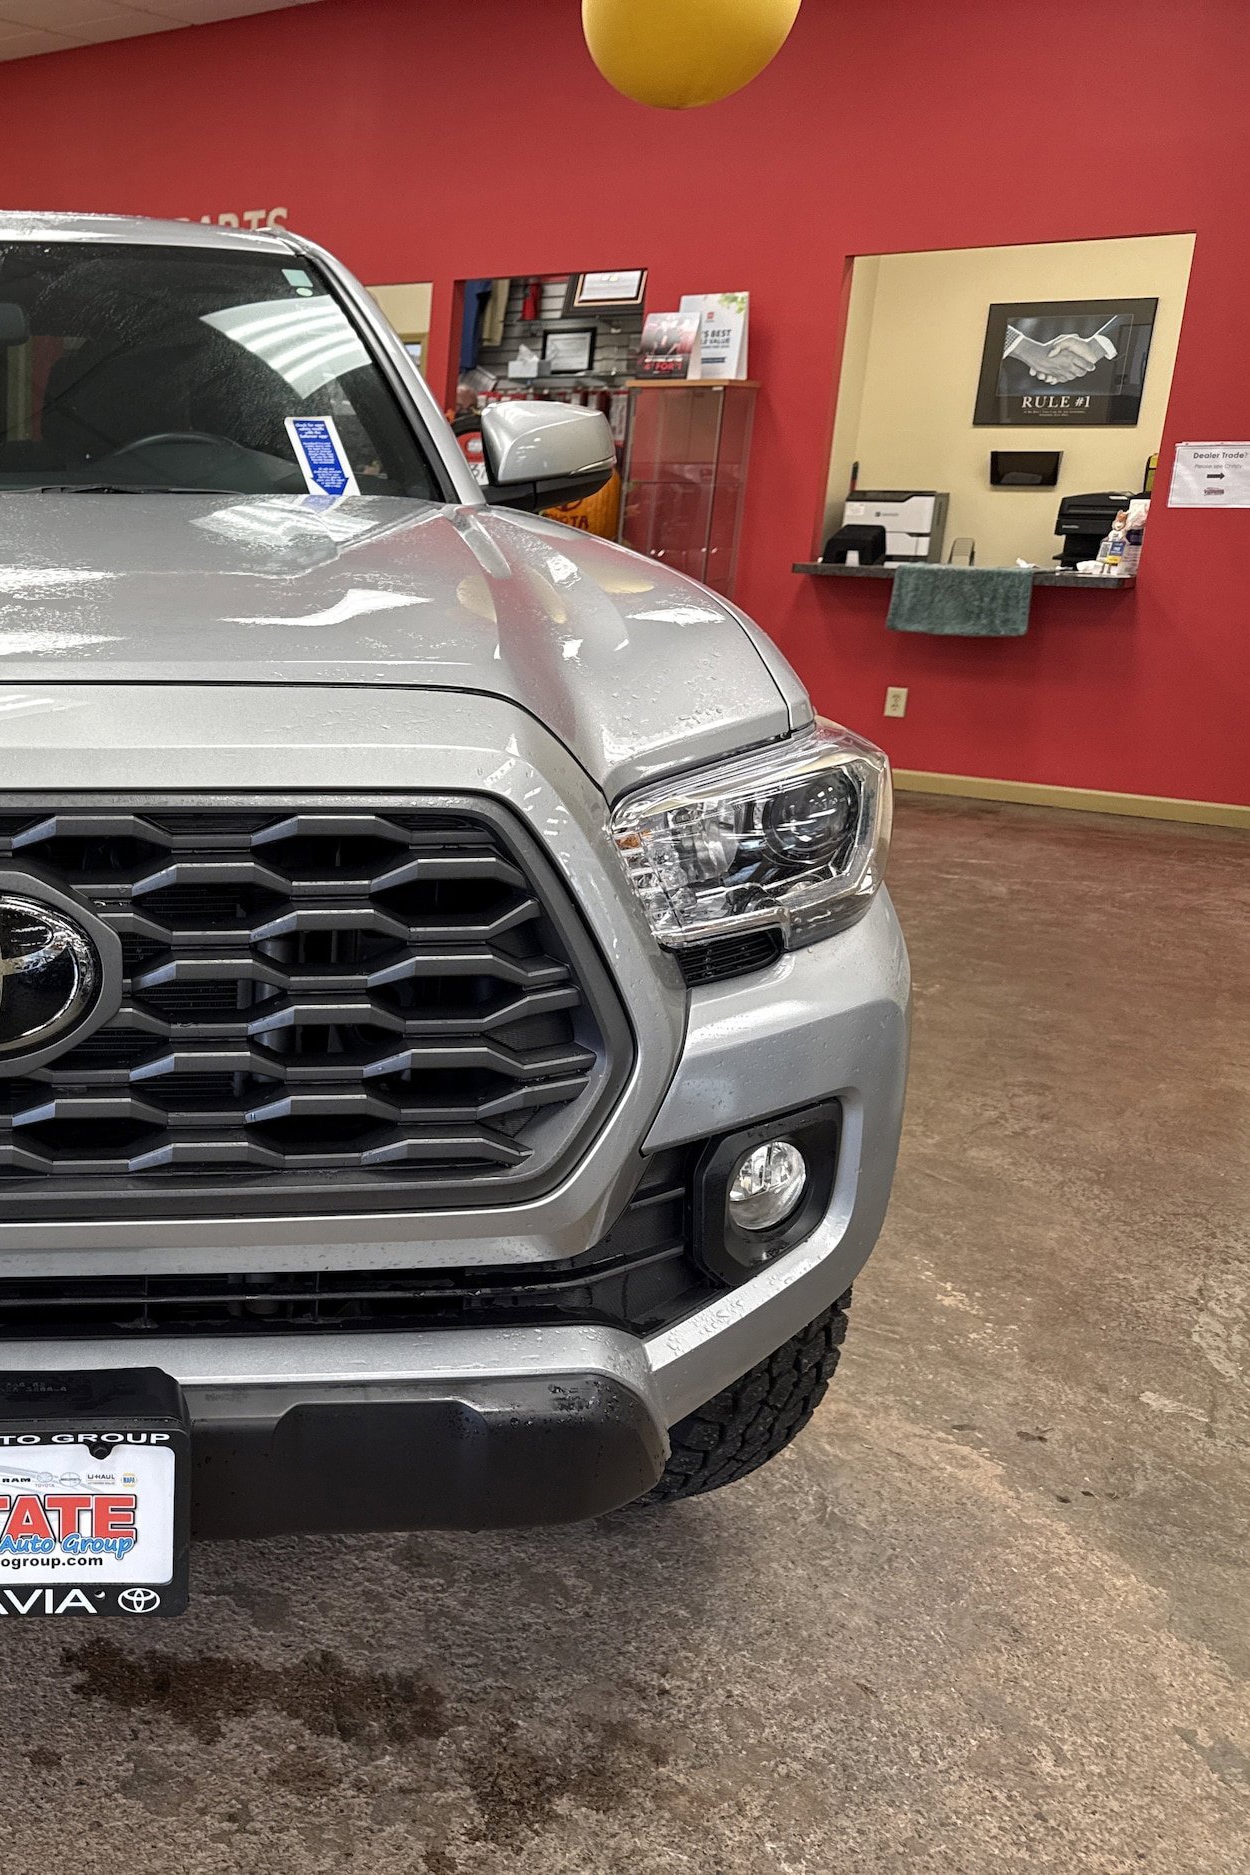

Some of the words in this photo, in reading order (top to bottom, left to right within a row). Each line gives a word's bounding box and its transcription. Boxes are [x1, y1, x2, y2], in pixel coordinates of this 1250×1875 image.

[1021, 396, 1070, 408] RULE
[1075, 396, 1091, 408] #1
[51, 1432, 171, 1445] GROUP
[61, 1534, 135, 1559] Group
